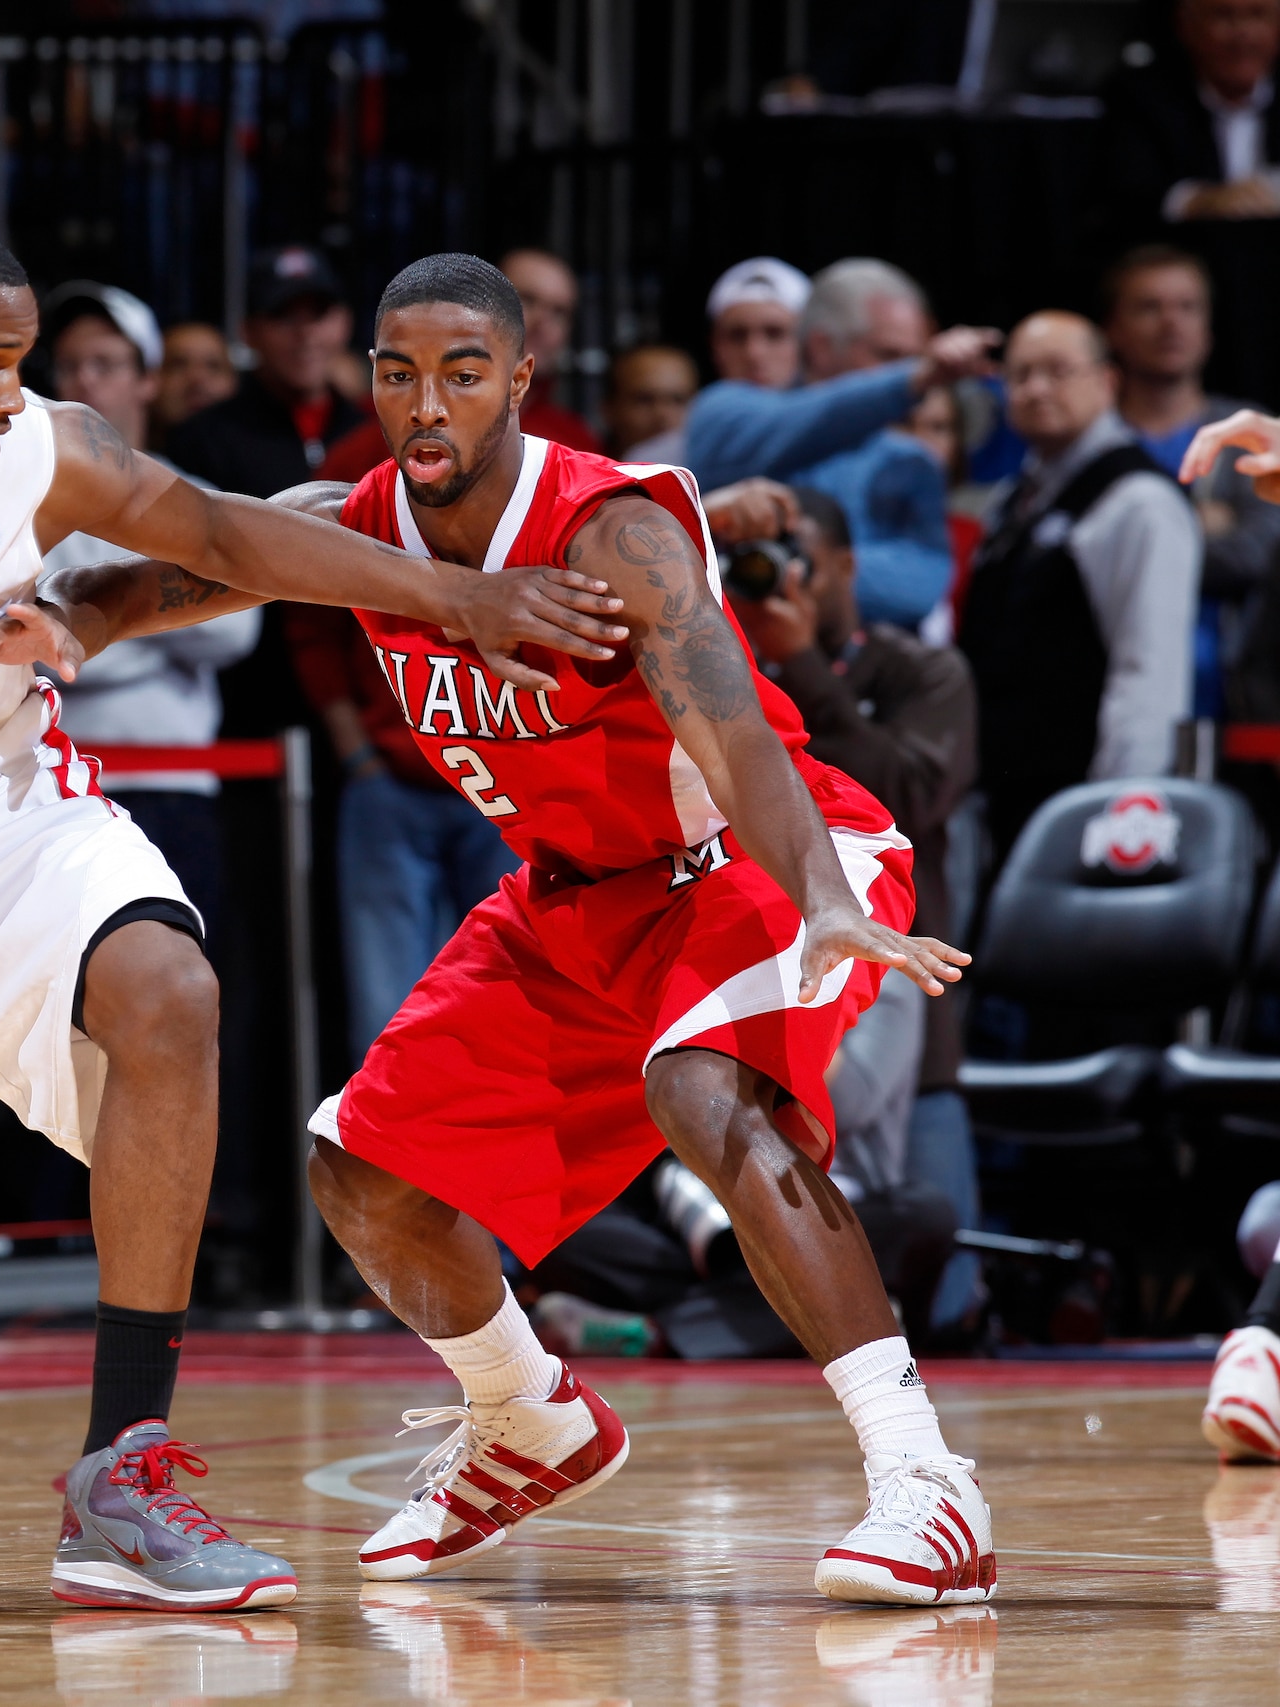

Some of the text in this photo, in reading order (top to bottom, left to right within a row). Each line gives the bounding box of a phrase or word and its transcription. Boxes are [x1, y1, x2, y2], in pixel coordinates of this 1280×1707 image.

[375, 645, 570, 739] IAMI
[441, 745, 519, 817] 2
[668, 830, 733, 894] M
